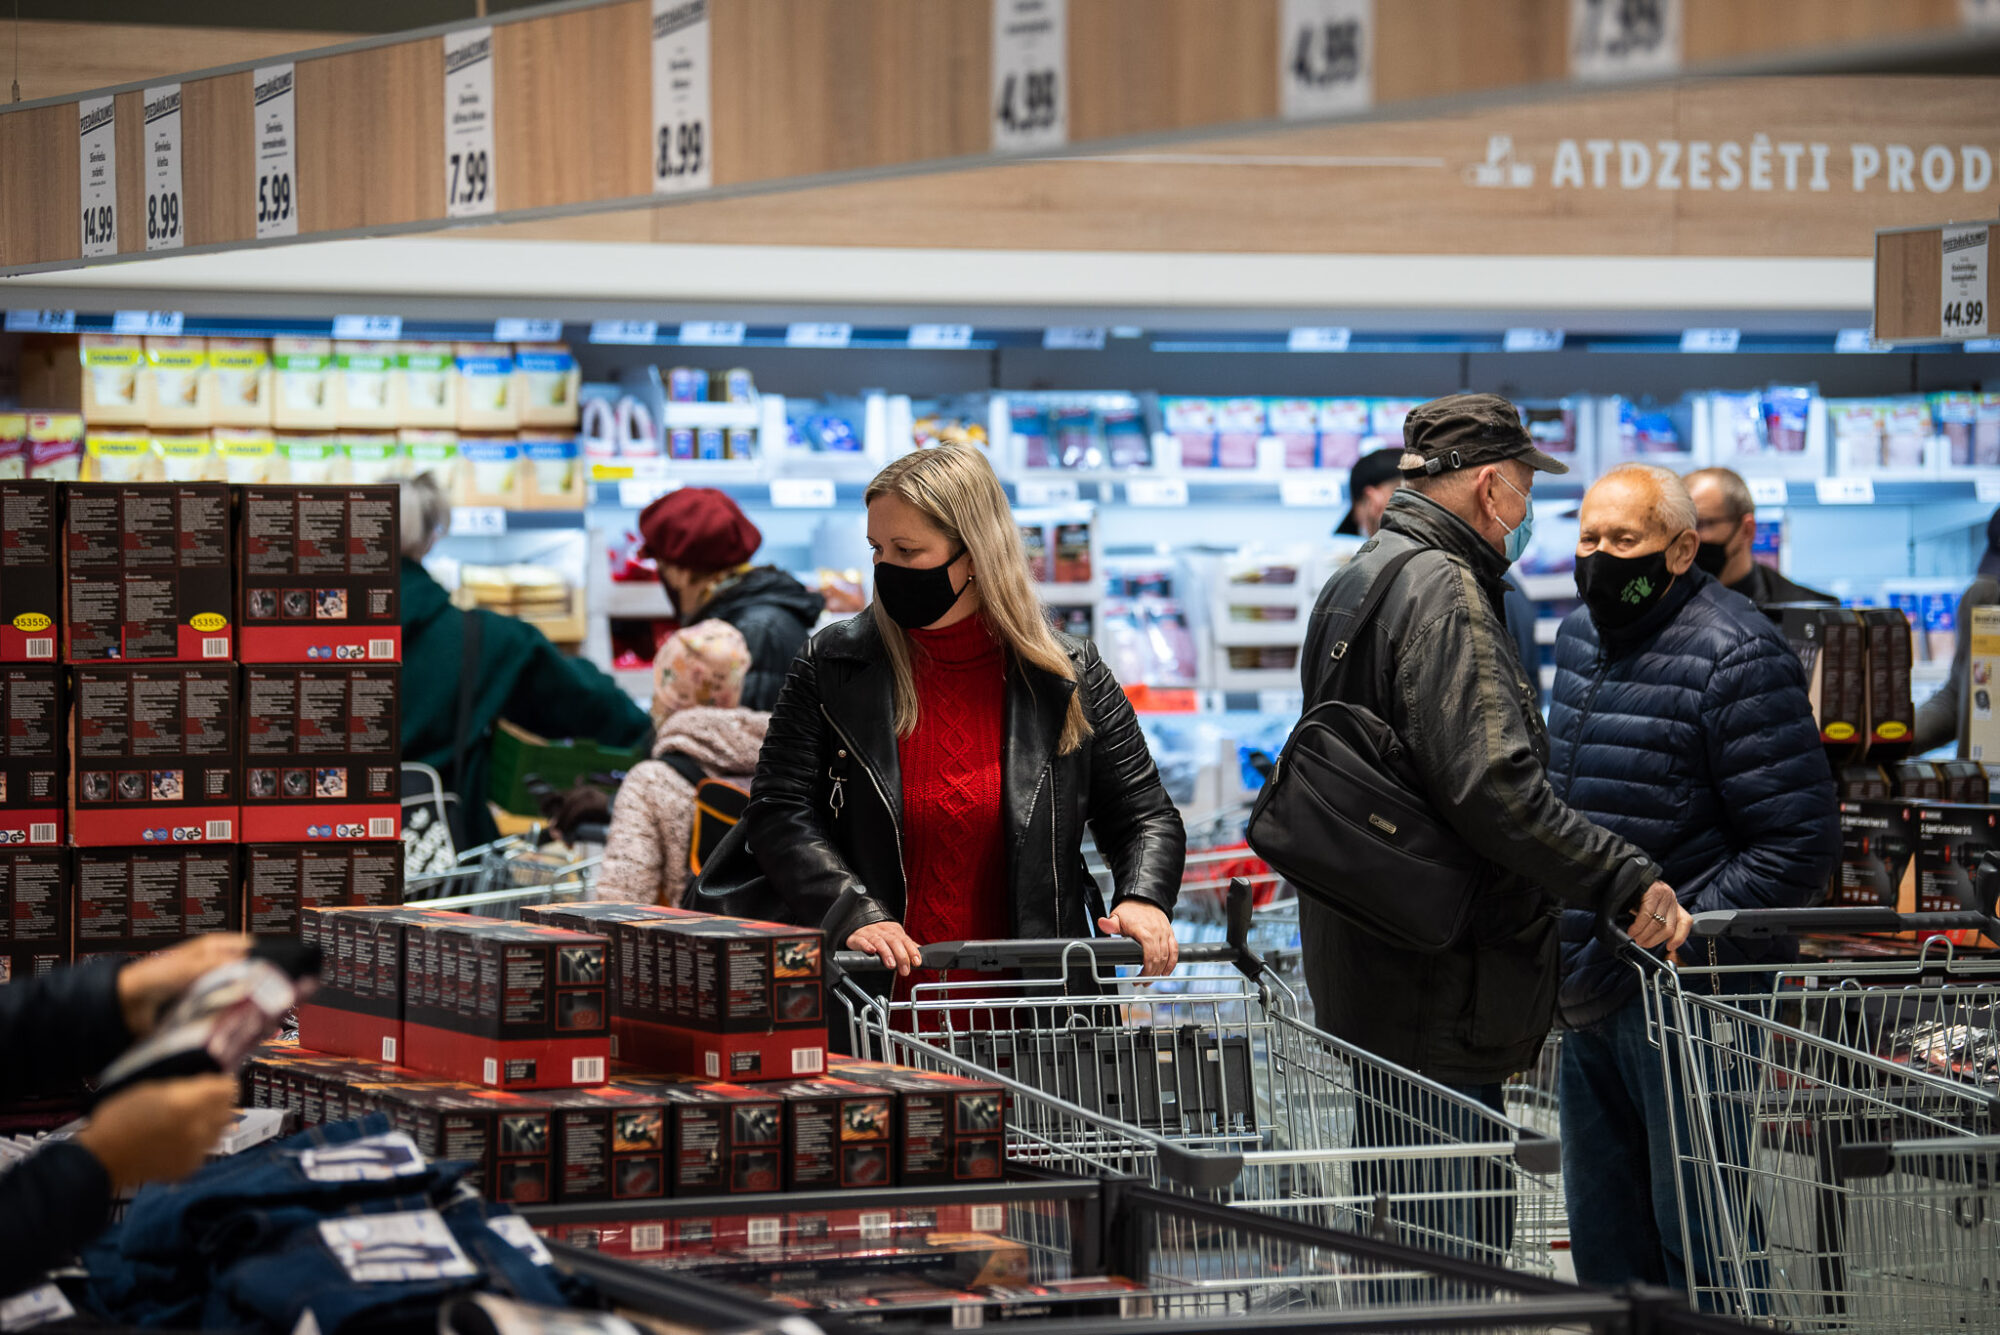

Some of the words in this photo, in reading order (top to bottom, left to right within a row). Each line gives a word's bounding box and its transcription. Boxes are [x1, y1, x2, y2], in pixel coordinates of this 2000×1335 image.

[657, 121, 701, 178] 8.99
[1551, 132, 1830, 191] ATDZESĒTI
[258, 173, 290, 223] 5.99
[450, 149, 487, 205] 7.99
[83, 205, 113, 244] 14.99
[148, 192, 179, 240] 8.99
[1943, 300, 1984, 328] 44.99
[15, 617, 51, 627] 353555
